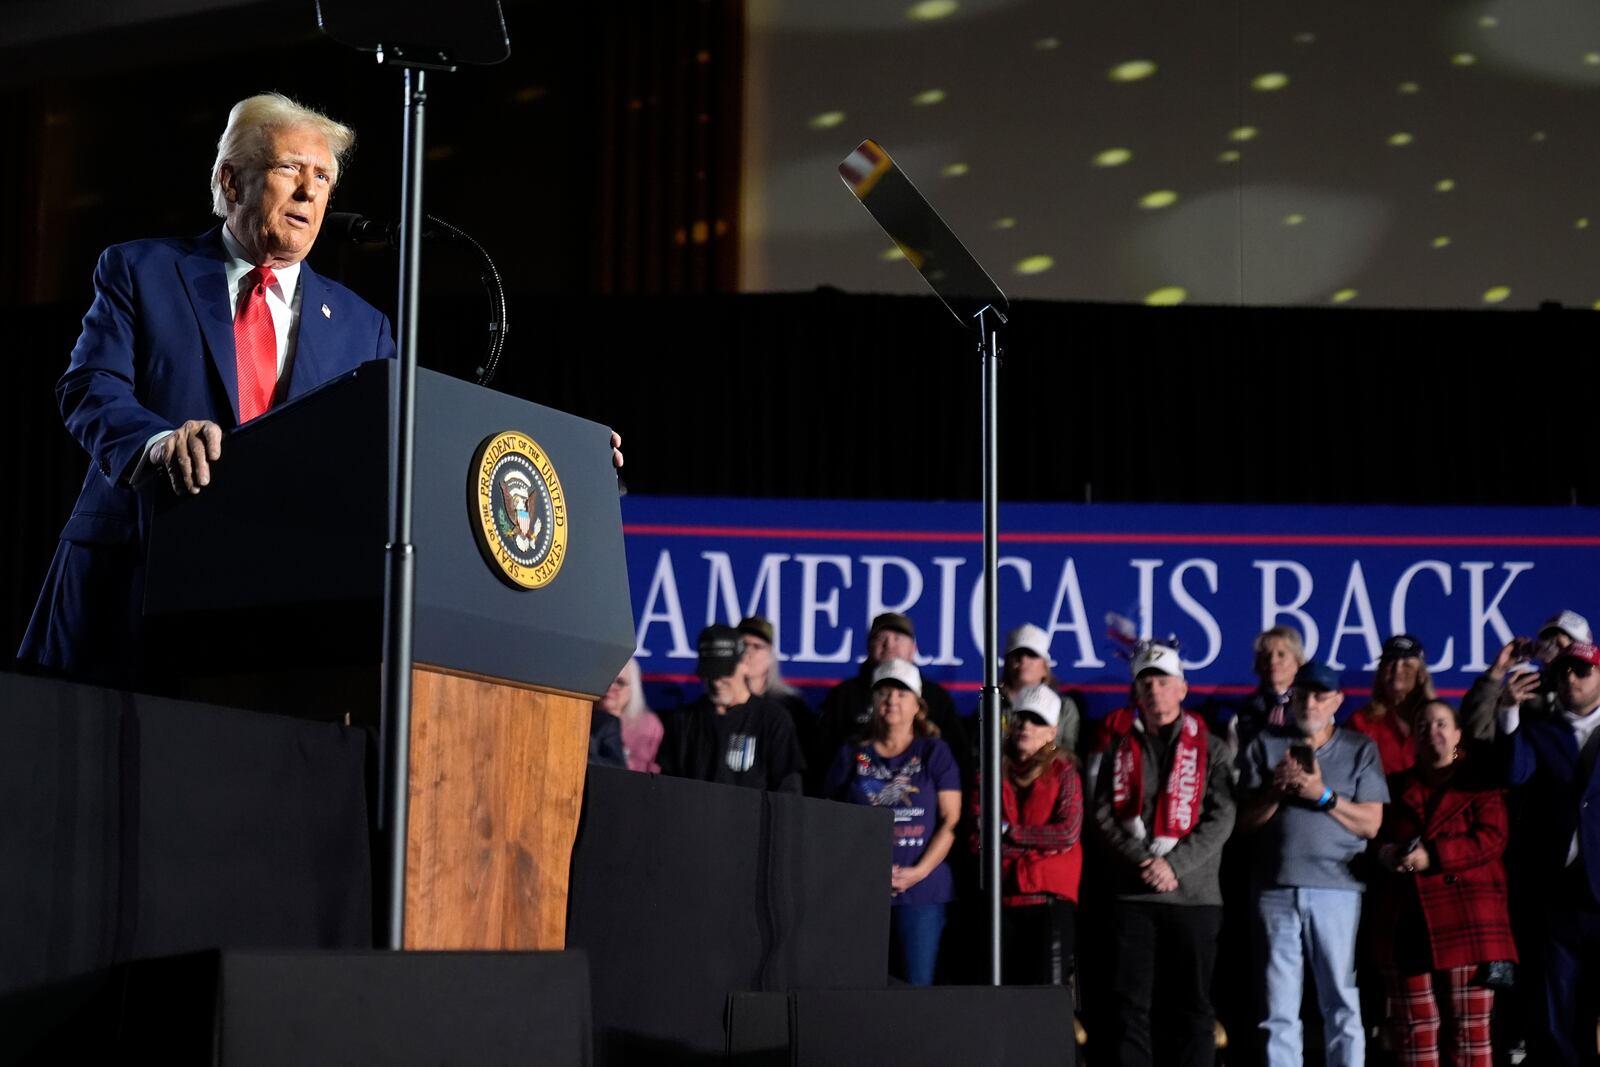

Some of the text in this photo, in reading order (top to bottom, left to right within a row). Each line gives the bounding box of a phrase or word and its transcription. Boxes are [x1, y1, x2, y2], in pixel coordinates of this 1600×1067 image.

[480, 436, 517, 497] PRESIDENT
[518, 440, 527, 451] OF
[528, 446, 540, 462] THE
[541, 463, 564, 527] UNITED
[487, 528, 496, 541] OF
[496, 541, 520, 578] SEAL
[534, 540, 562, 582] STATES
[633, 549, 1538, 673] AMERICA IS BACK
[1176, 747, 1198, 830] TRUMP
